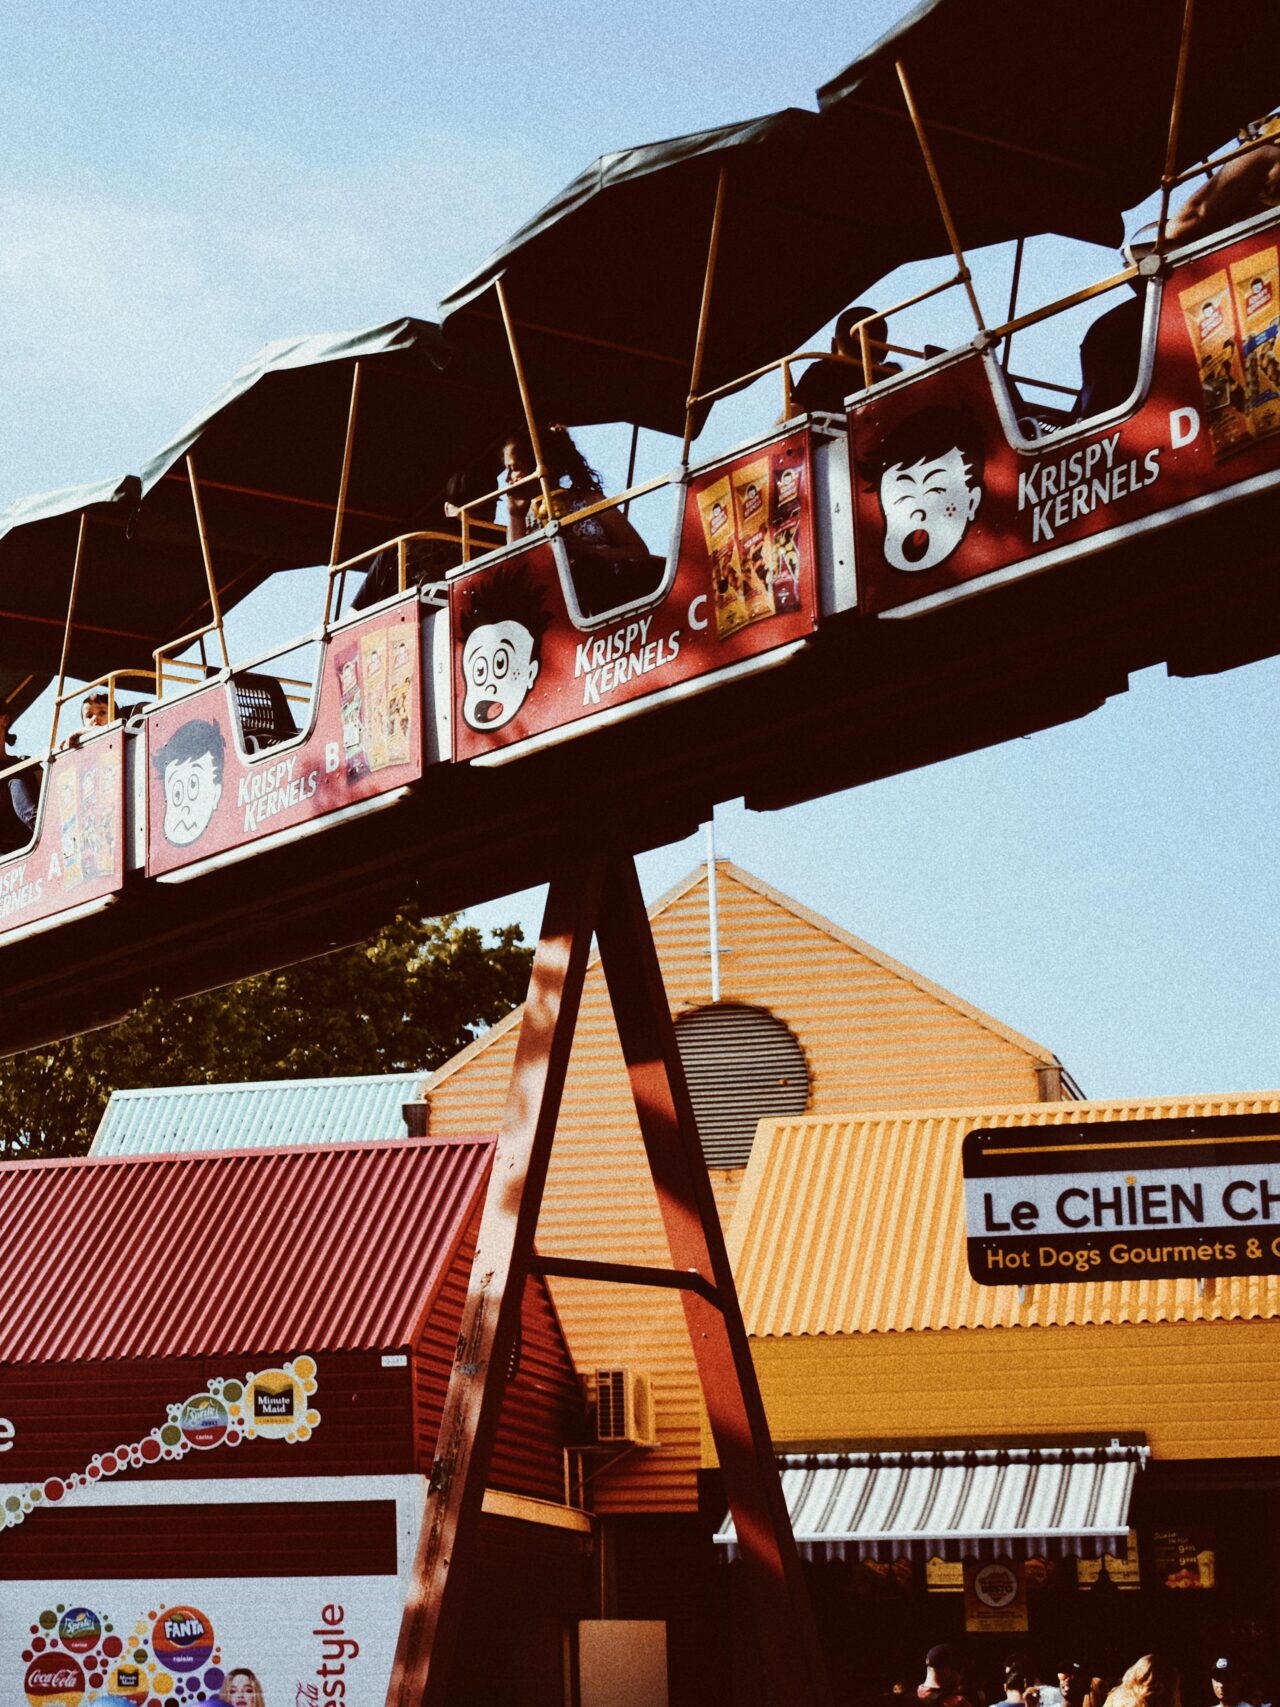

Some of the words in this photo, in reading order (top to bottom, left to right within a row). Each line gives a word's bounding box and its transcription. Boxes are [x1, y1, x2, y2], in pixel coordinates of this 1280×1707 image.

[1169, 407, 1201, 450] D
[1017, 433, 1121, 512] KRISPY
[1032, 449, 1161, 543] KERNELS
[688, 594, 708, 631] C
[573, 615, 653, 678] KRISPY
[582, 630, 680, 706] KERNELS
[325, 741, 340, 774] B
[237, 756, 297, 808] KRISPY
[243, 770, 318, 833] KERNELS
[47, 852, 61, 881] A
[983, 1193, 1039, 1232] Le
[987, 1248, 1030, 1269] Hot
[1039, 1247, 1102, 1272] Dogs
[1109, 1240, 1237, 1265] Gourmets
[1246, 1238, 1263, 1259] &
[258, 1396, 290, 1405] Minute
[262, 1405, 286, 1413] Maid
[165, 1619, 204, 1639] FANTA
